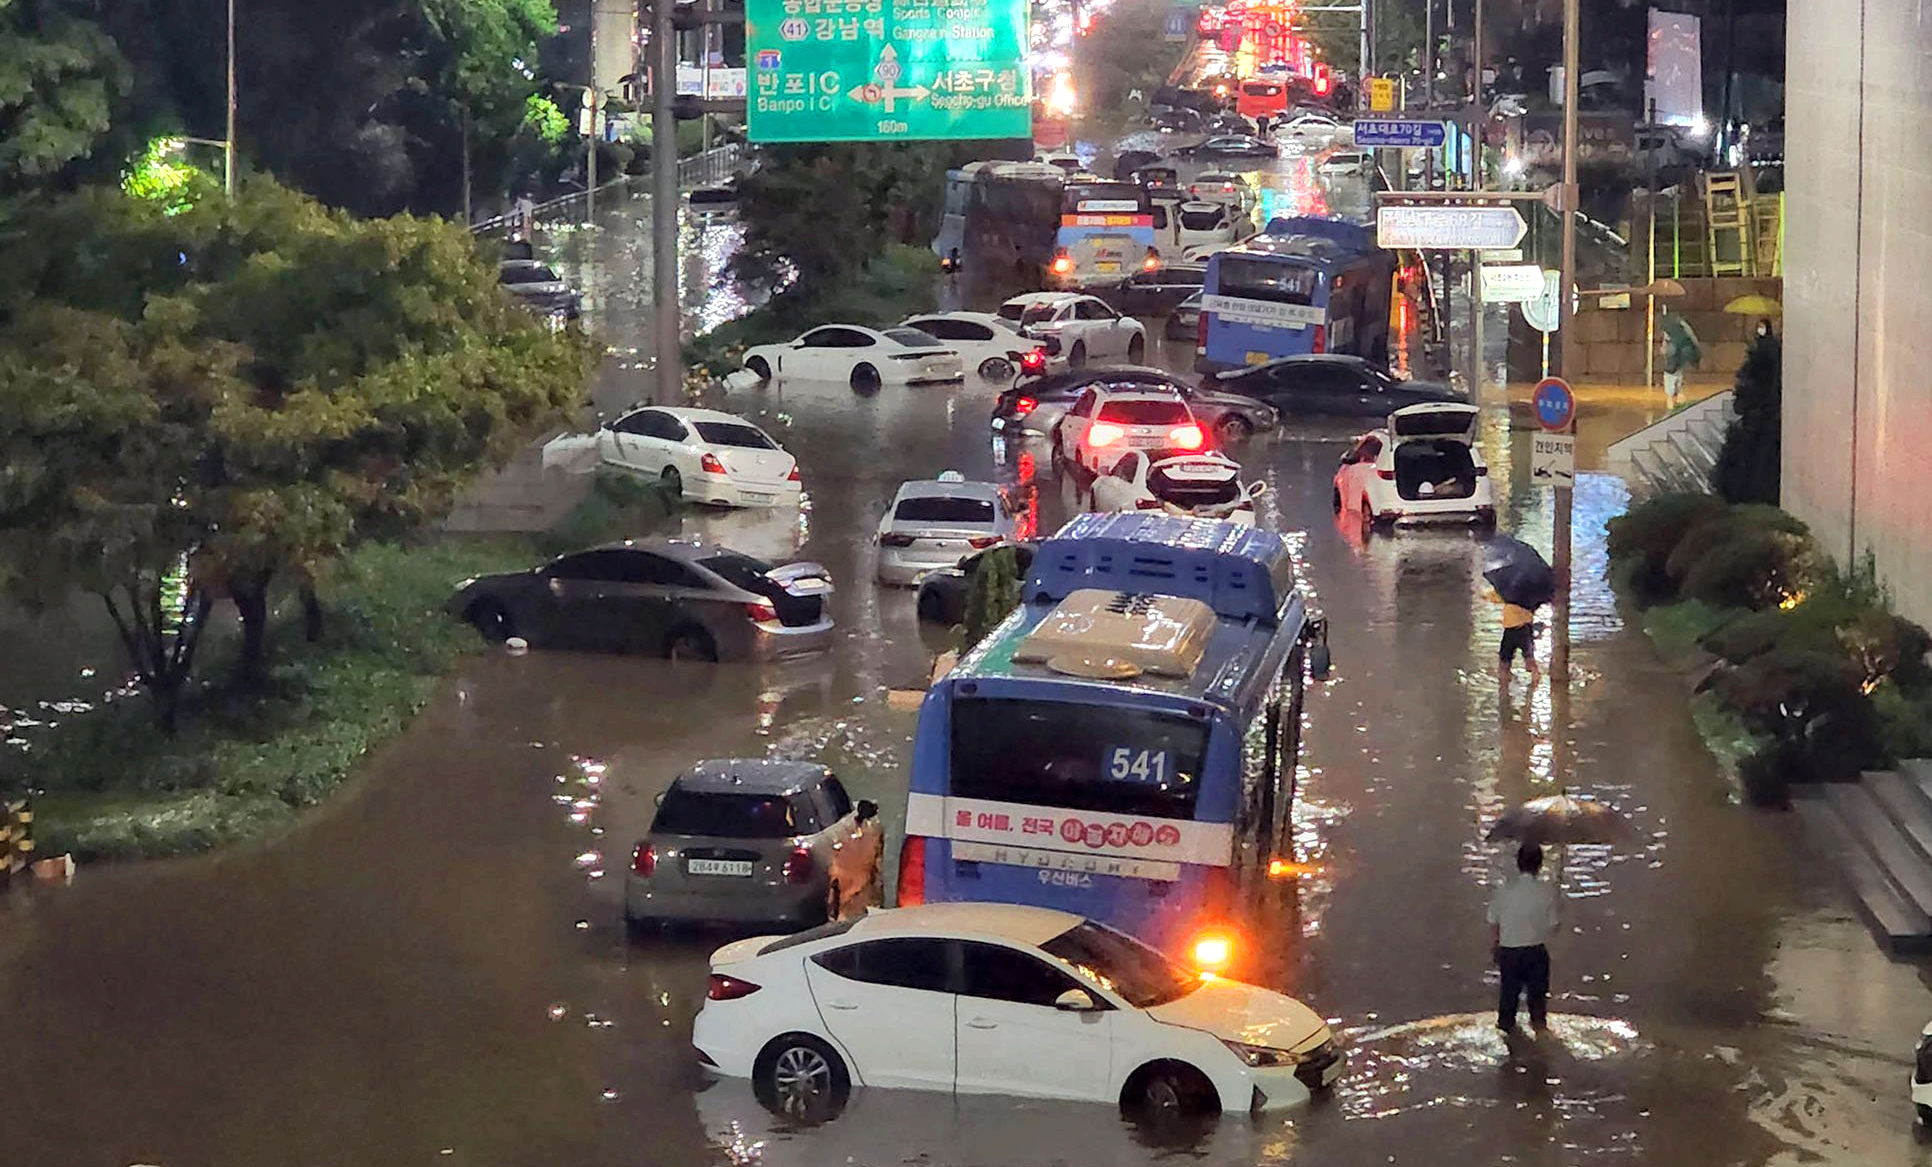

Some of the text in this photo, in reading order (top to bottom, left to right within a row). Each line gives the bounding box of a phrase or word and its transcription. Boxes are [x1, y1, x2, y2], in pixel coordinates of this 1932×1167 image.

[787, 23, 802, 36] 41
[815, 17, 885, 41] 강남역
[952, 25, 994, 39] Station
[882, 64, 898, 77] 90
[757, 97, 805, 114] Banpo
[877, 120, 908, 134] 160m
[1279, 278, 1301, 293] 541
[1535, 440, 1573, 456] 견인지역
[1111, 747, 1166, 782] 541
[1022, 817, 1055, 835] 전국
[1038, 869, 1094, 888] 우신버스
